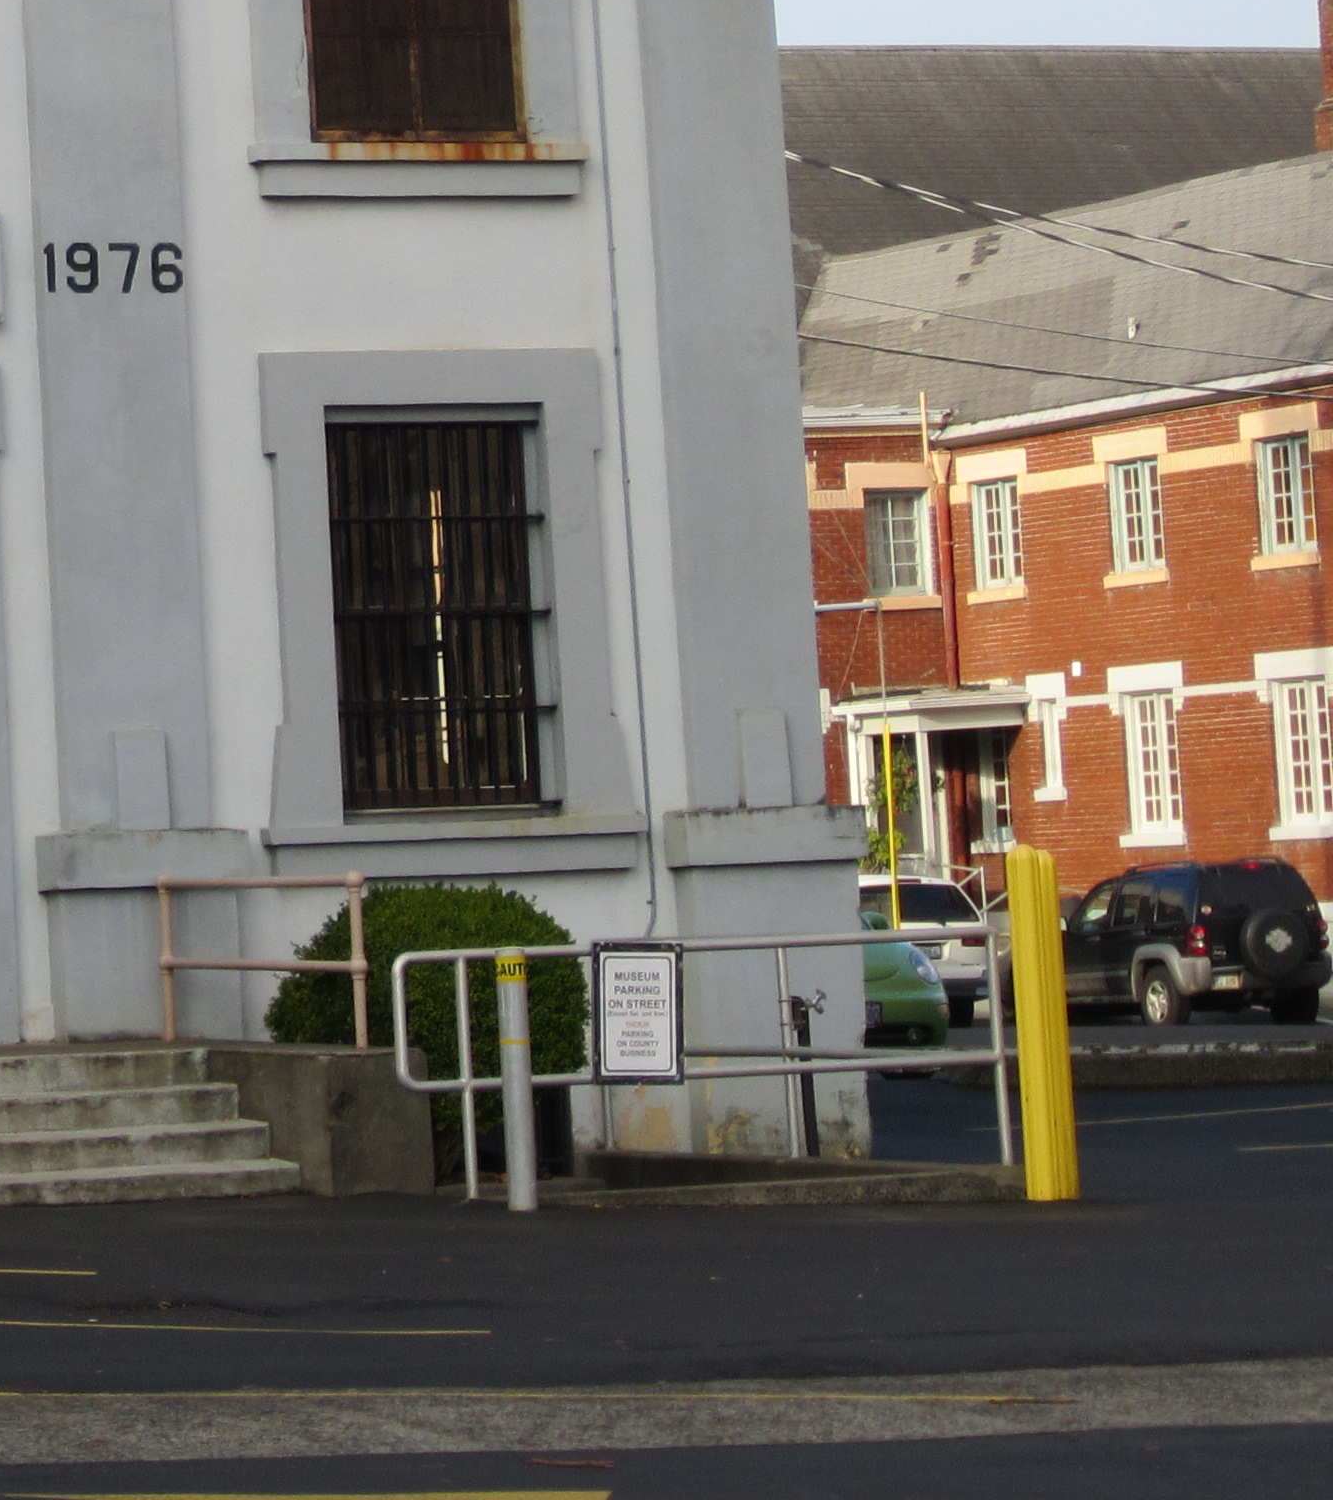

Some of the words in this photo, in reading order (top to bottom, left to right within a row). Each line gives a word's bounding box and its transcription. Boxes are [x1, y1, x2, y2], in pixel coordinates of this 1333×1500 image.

[42, 241, 184, 294] 1976
[613, 971, 660, 981] MUSEUM
[613, 985, 661, 995] PARKING
[608, 999, 624, 1009] ON
[626, 999, 667, 1009] STREET
